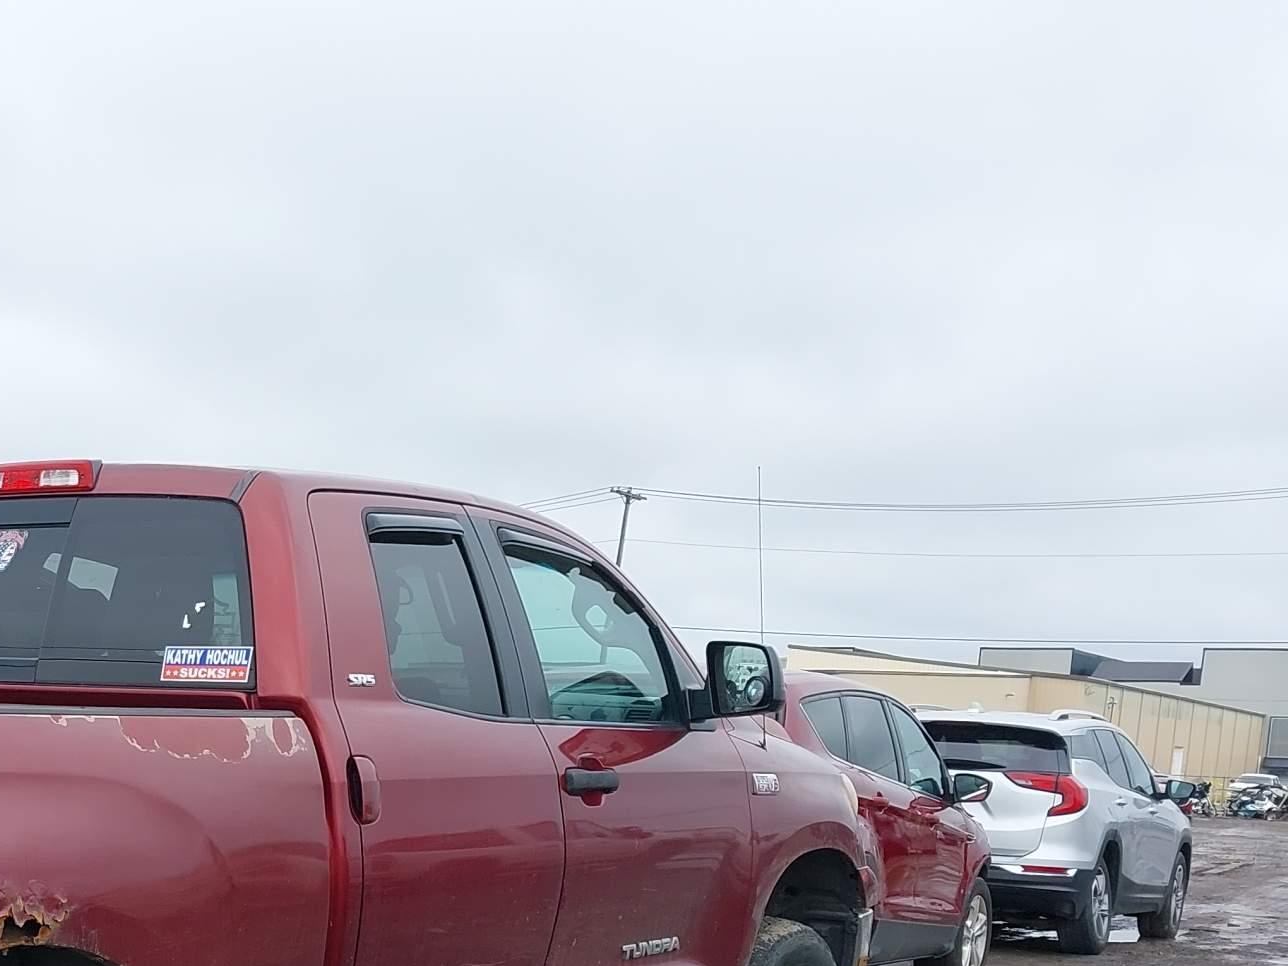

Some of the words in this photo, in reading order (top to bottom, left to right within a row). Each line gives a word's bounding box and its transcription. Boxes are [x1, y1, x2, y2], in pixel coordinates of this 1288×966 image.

[166, 649, 204, 665] KATHY
[205, 648, 249, 665] HOCHUL
[179, 667, 231, 679] SUCKS!
[622, 936, 680, 961] TUNDRA
